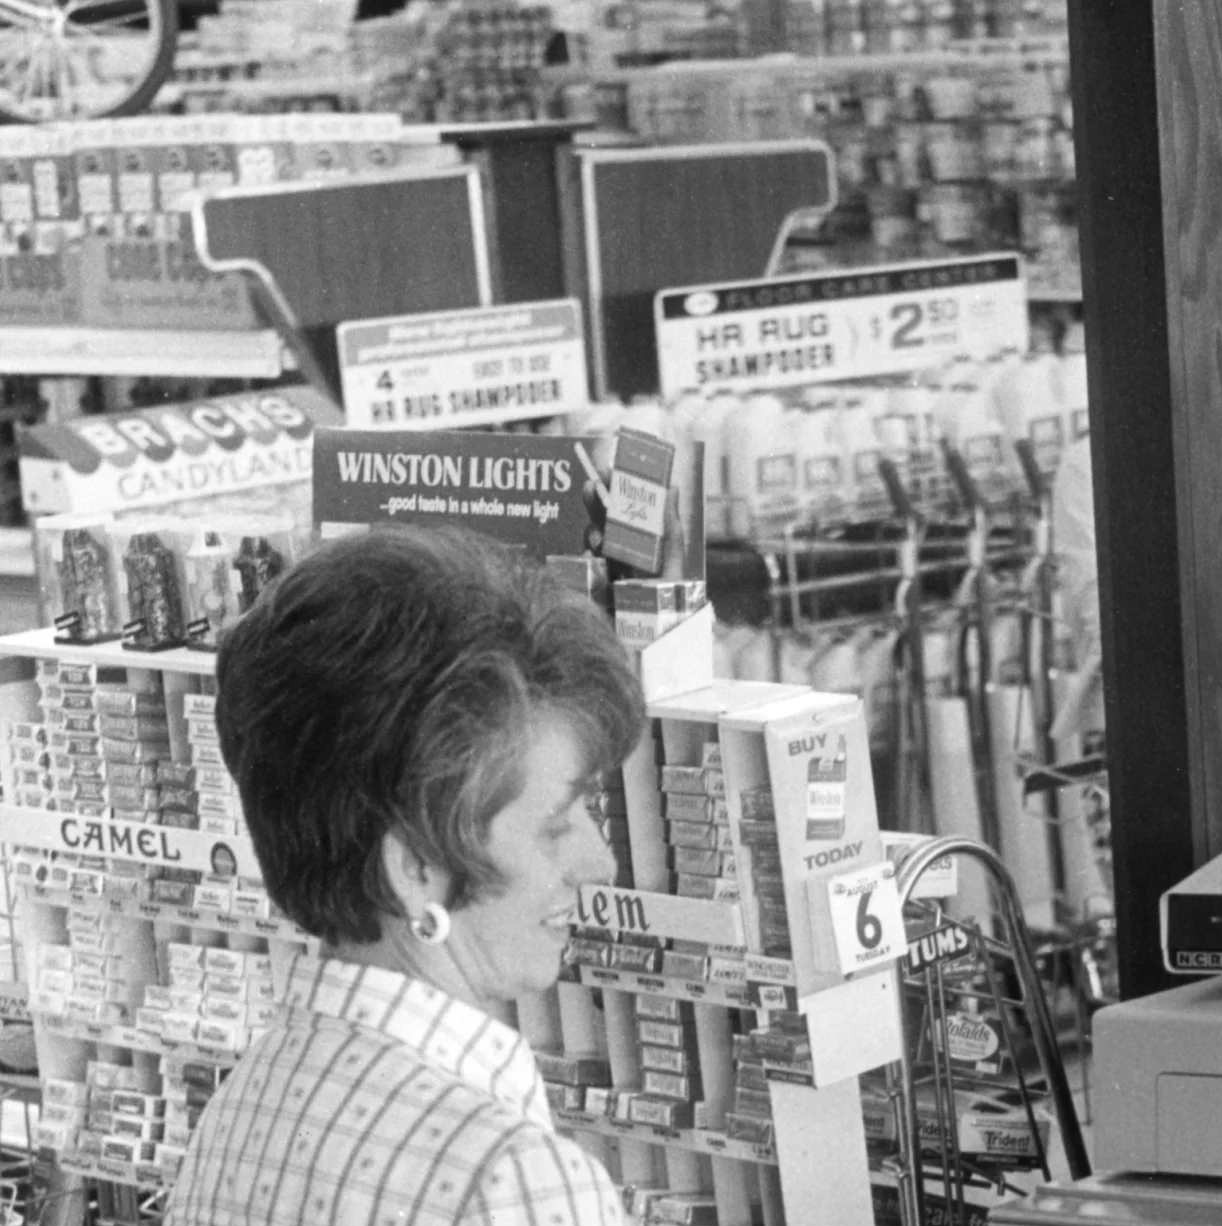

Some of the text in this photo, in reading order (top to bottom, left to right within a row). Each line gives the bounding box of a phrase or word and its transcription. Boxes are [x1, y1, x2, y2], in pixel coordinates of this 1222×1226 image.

[759, 313, 829, 344] RUG
[337, 452, 572, 492] WINSTON LIGHTS
[618, 474, 658, 508] Winston
[417, 497, 448, 514] taste
[448, 496, 459, 514] in
[460, 502, 469, 515] a
[470, 498, 505, 516] whole
[506, 503, 532, 518] new
[533, 501, 560, 524] light
[787, 733, 828, 756] BUY
[60, 818, 181, 861] CAMEL
[803, 840, 864, 870] TODAY
[846, 880, 879, 897] AUGUST
[576, 887, 651, 932] lem
[855, 892, 883, 950] 6
[854, 945, 891, 963] TUESDAY
[908, 926, 969, 968] TUMS
[984, 1130, 1031, 1148] Trident
